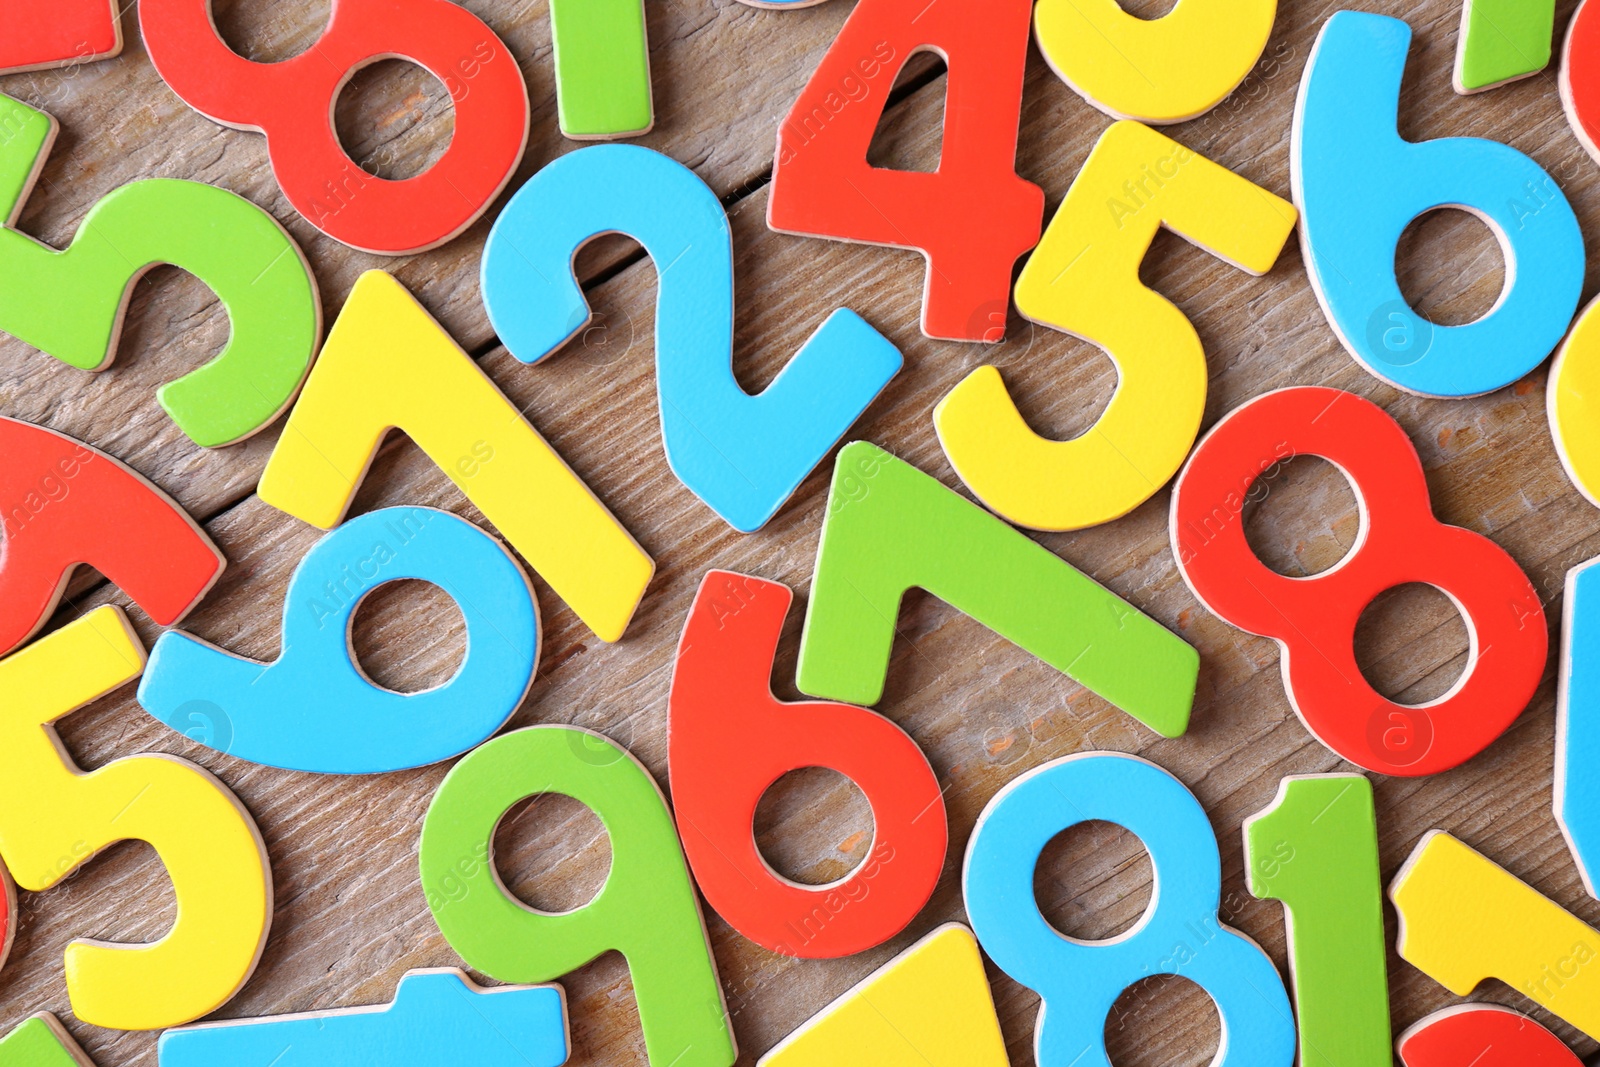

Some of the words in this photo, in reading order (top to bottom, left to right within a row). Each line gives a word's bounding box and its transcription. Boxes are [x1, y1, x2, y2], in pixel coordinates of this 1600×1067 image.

[480, 143, 904, 534] 2
[766, 0, 1046, 343] 4
[932, 119, 1297, 532] 5
[1290, 10, 1586, 399] 6
[257, 268, 656, 643] 7
[797, 440, 1201, 739] 7
[1169, 385, 1550, 778] 8
[0, 603, 274, 1031] 5
[418, 723, 738, 1067] 9
[667, 569, 949, 961] 6
[962, 751, 1298, 1067] 8
[1242, 772, 1394, 1067] 1
